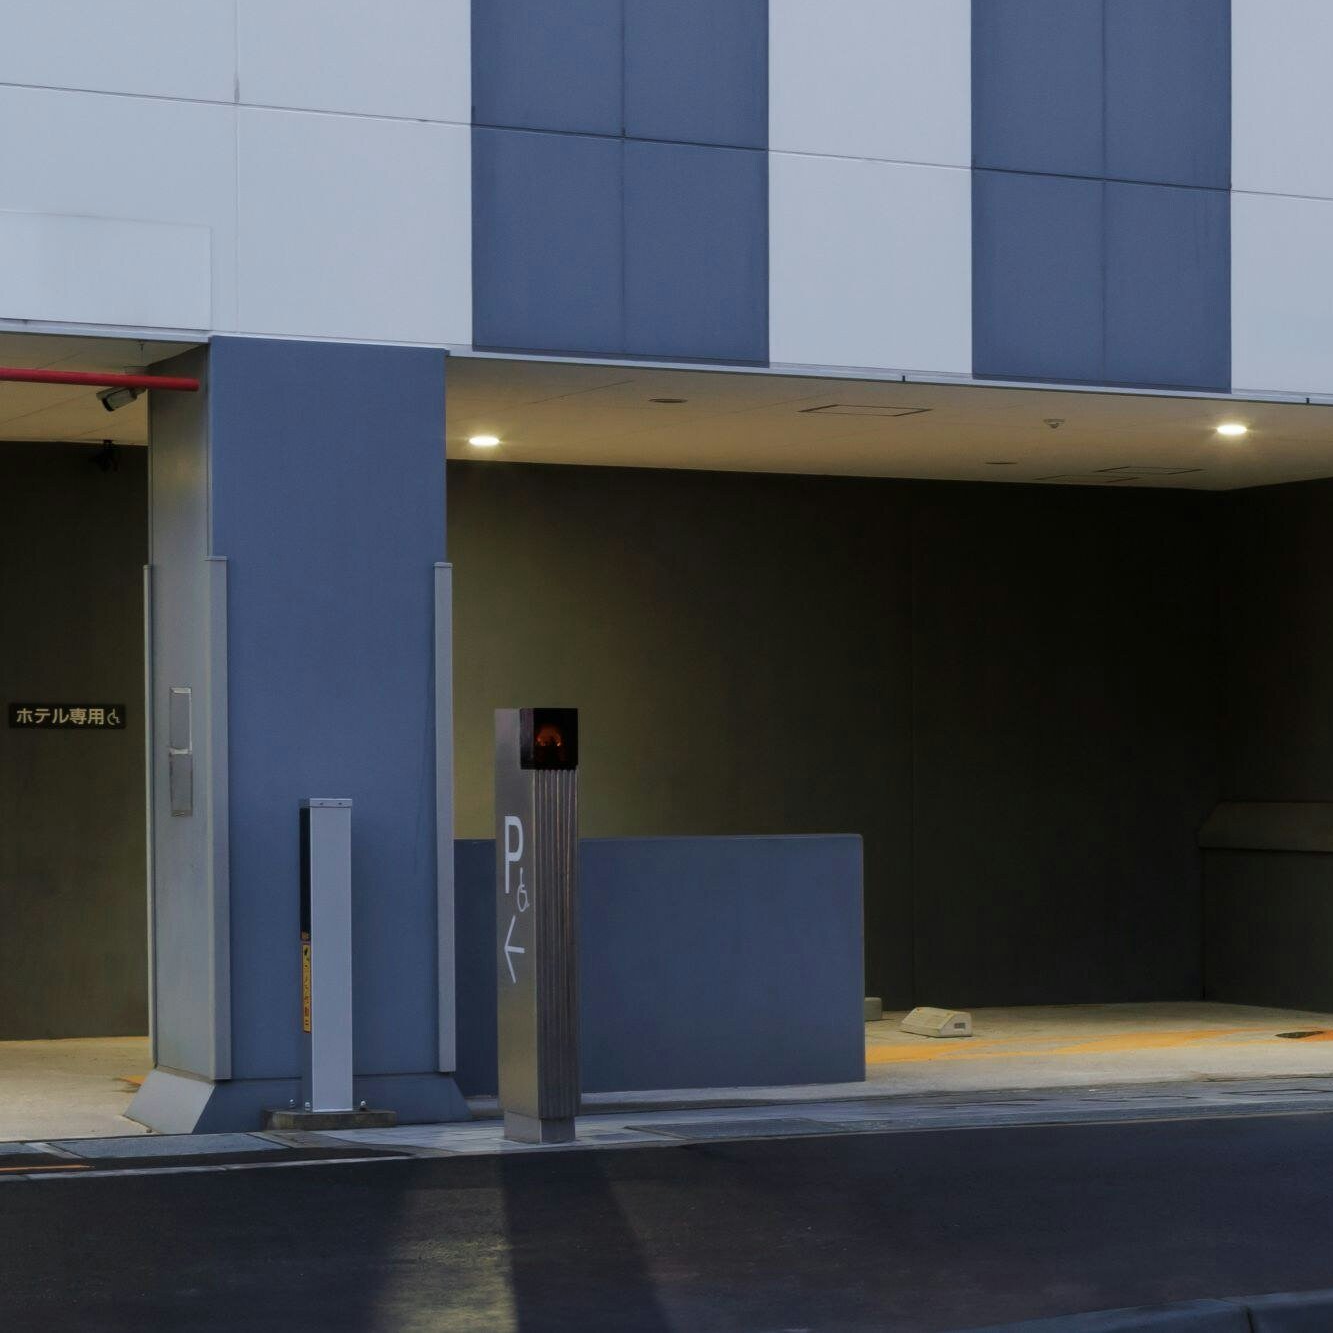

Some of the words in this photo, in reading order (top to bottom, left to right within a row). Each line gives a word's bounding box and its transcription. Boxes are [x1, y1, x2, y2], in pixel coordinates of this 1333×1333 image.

[16, 708, 105, 725] ホテル専用
[504, 815, 524, 894] P
